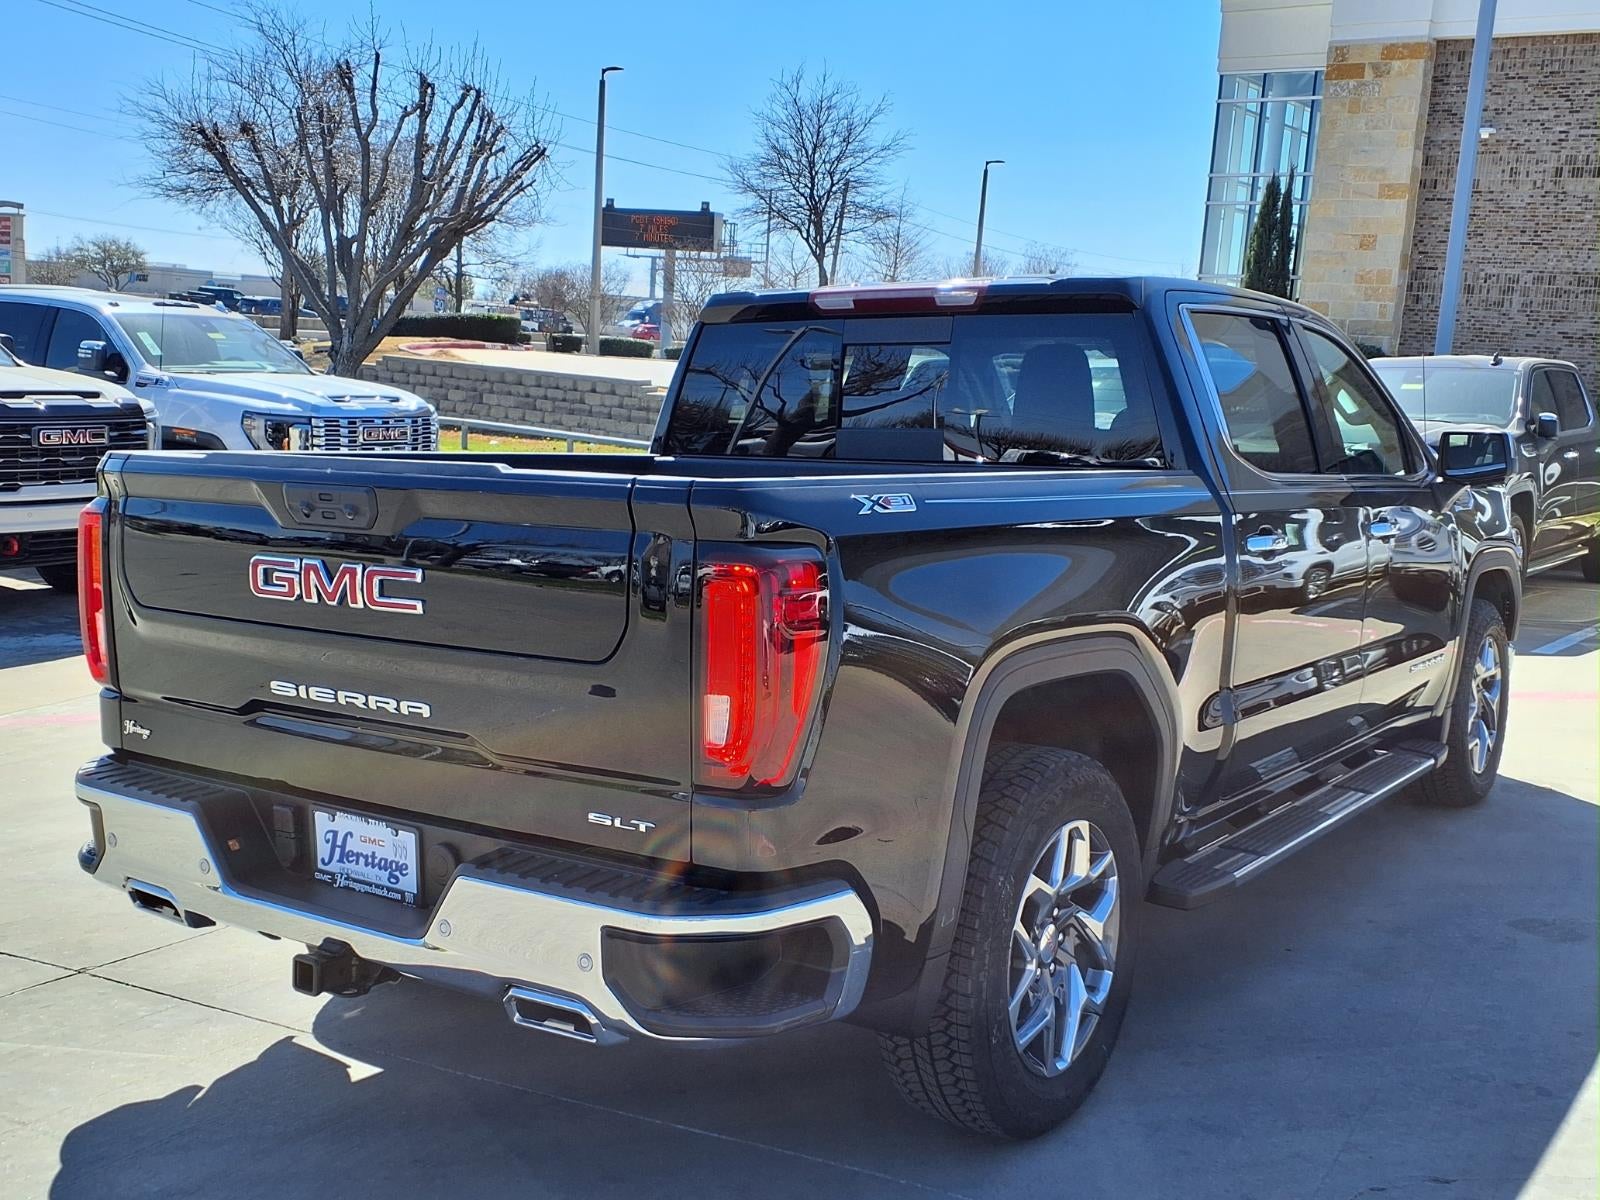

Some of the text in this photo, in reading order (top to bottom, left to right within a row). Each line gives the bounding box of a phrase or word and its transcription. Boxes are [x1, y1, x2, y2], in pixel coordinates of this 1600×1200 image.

[643, 233, 674, 243] MINUTES
[39, 428, 108, 446] GMC
[364, 428, 410, 443] GMC
[249, 553, 425, 616] GMC
[269, 680, 432, 719] SIERRA
[587, 811, 656, 833] SLT
[360, 834, 386, 848] GMC
[320, 829, 409, 885] Heritage
